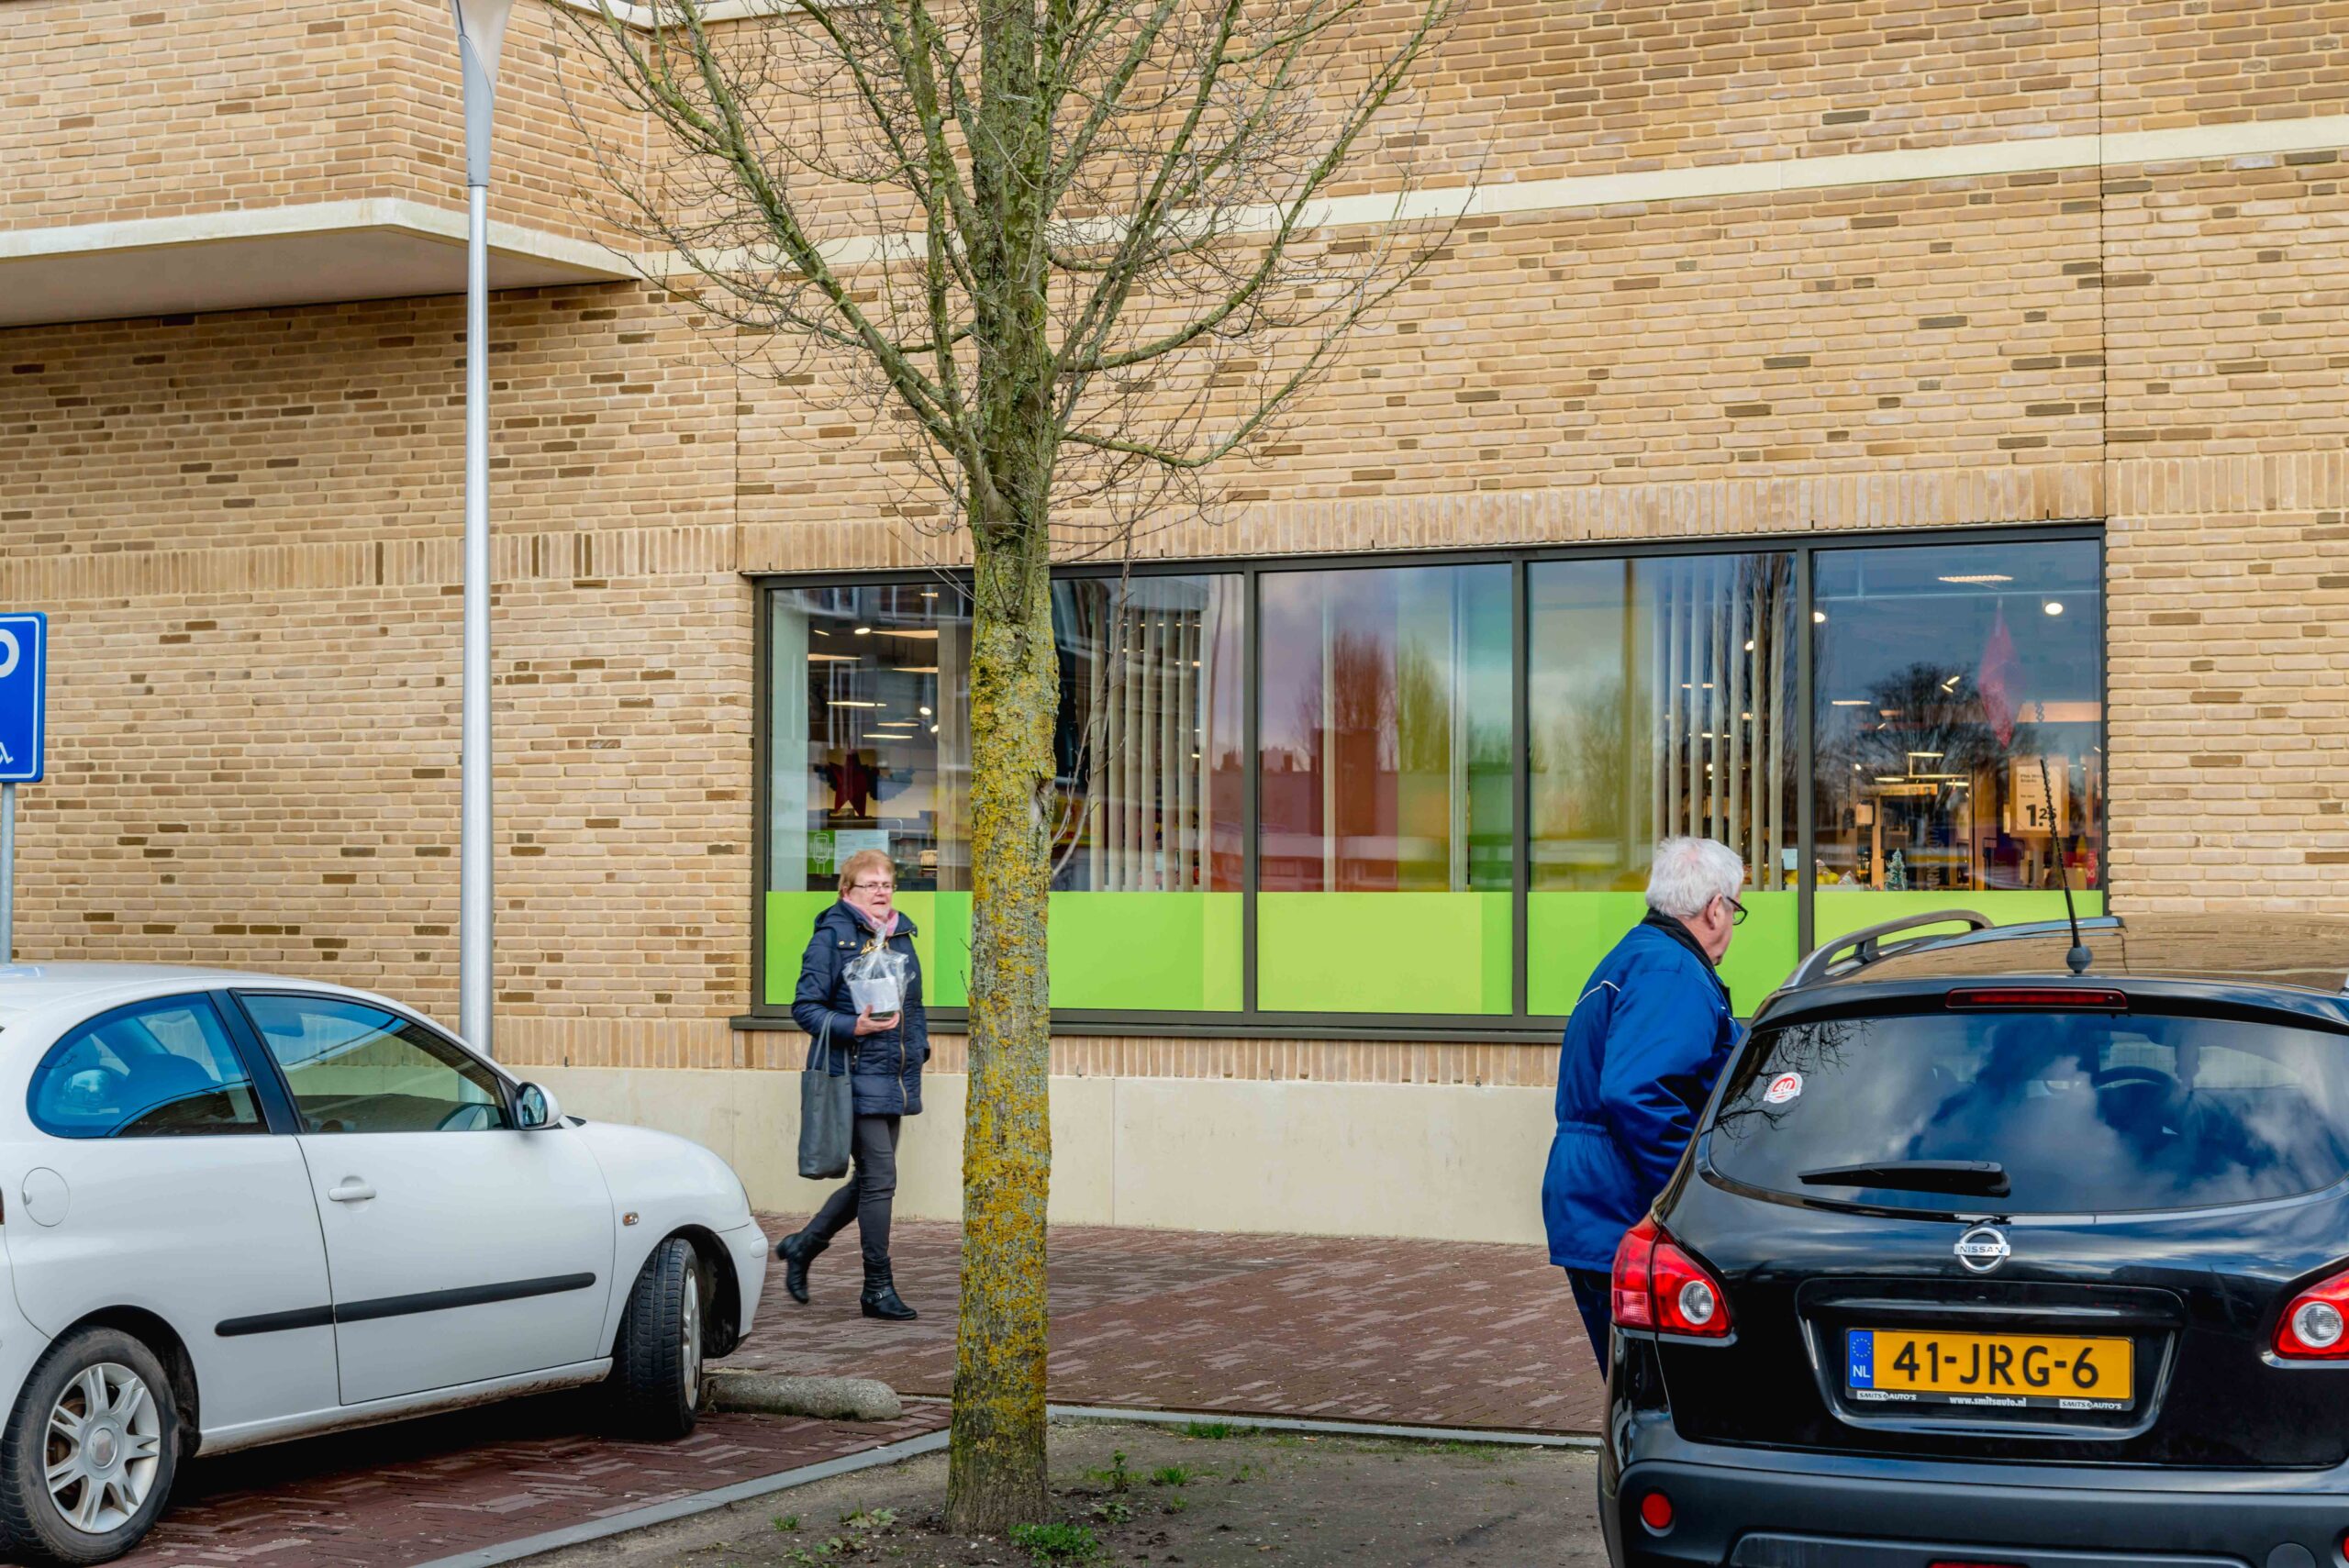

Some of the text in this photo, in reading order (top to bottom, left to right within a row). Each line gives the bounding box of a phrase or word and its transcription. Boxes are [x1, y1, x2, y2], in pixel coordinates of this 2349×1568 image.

[1927, 858, 1940, 890] ARKT
[1959, 1246, 2003, 1254] NISSAN
[1853, 1364, 1871, 1378] NL
[1893, 1340, 2099, 1389] 41-JRG-6
[1948, 1396, 2027, 1407] www.smitsauto.nl
